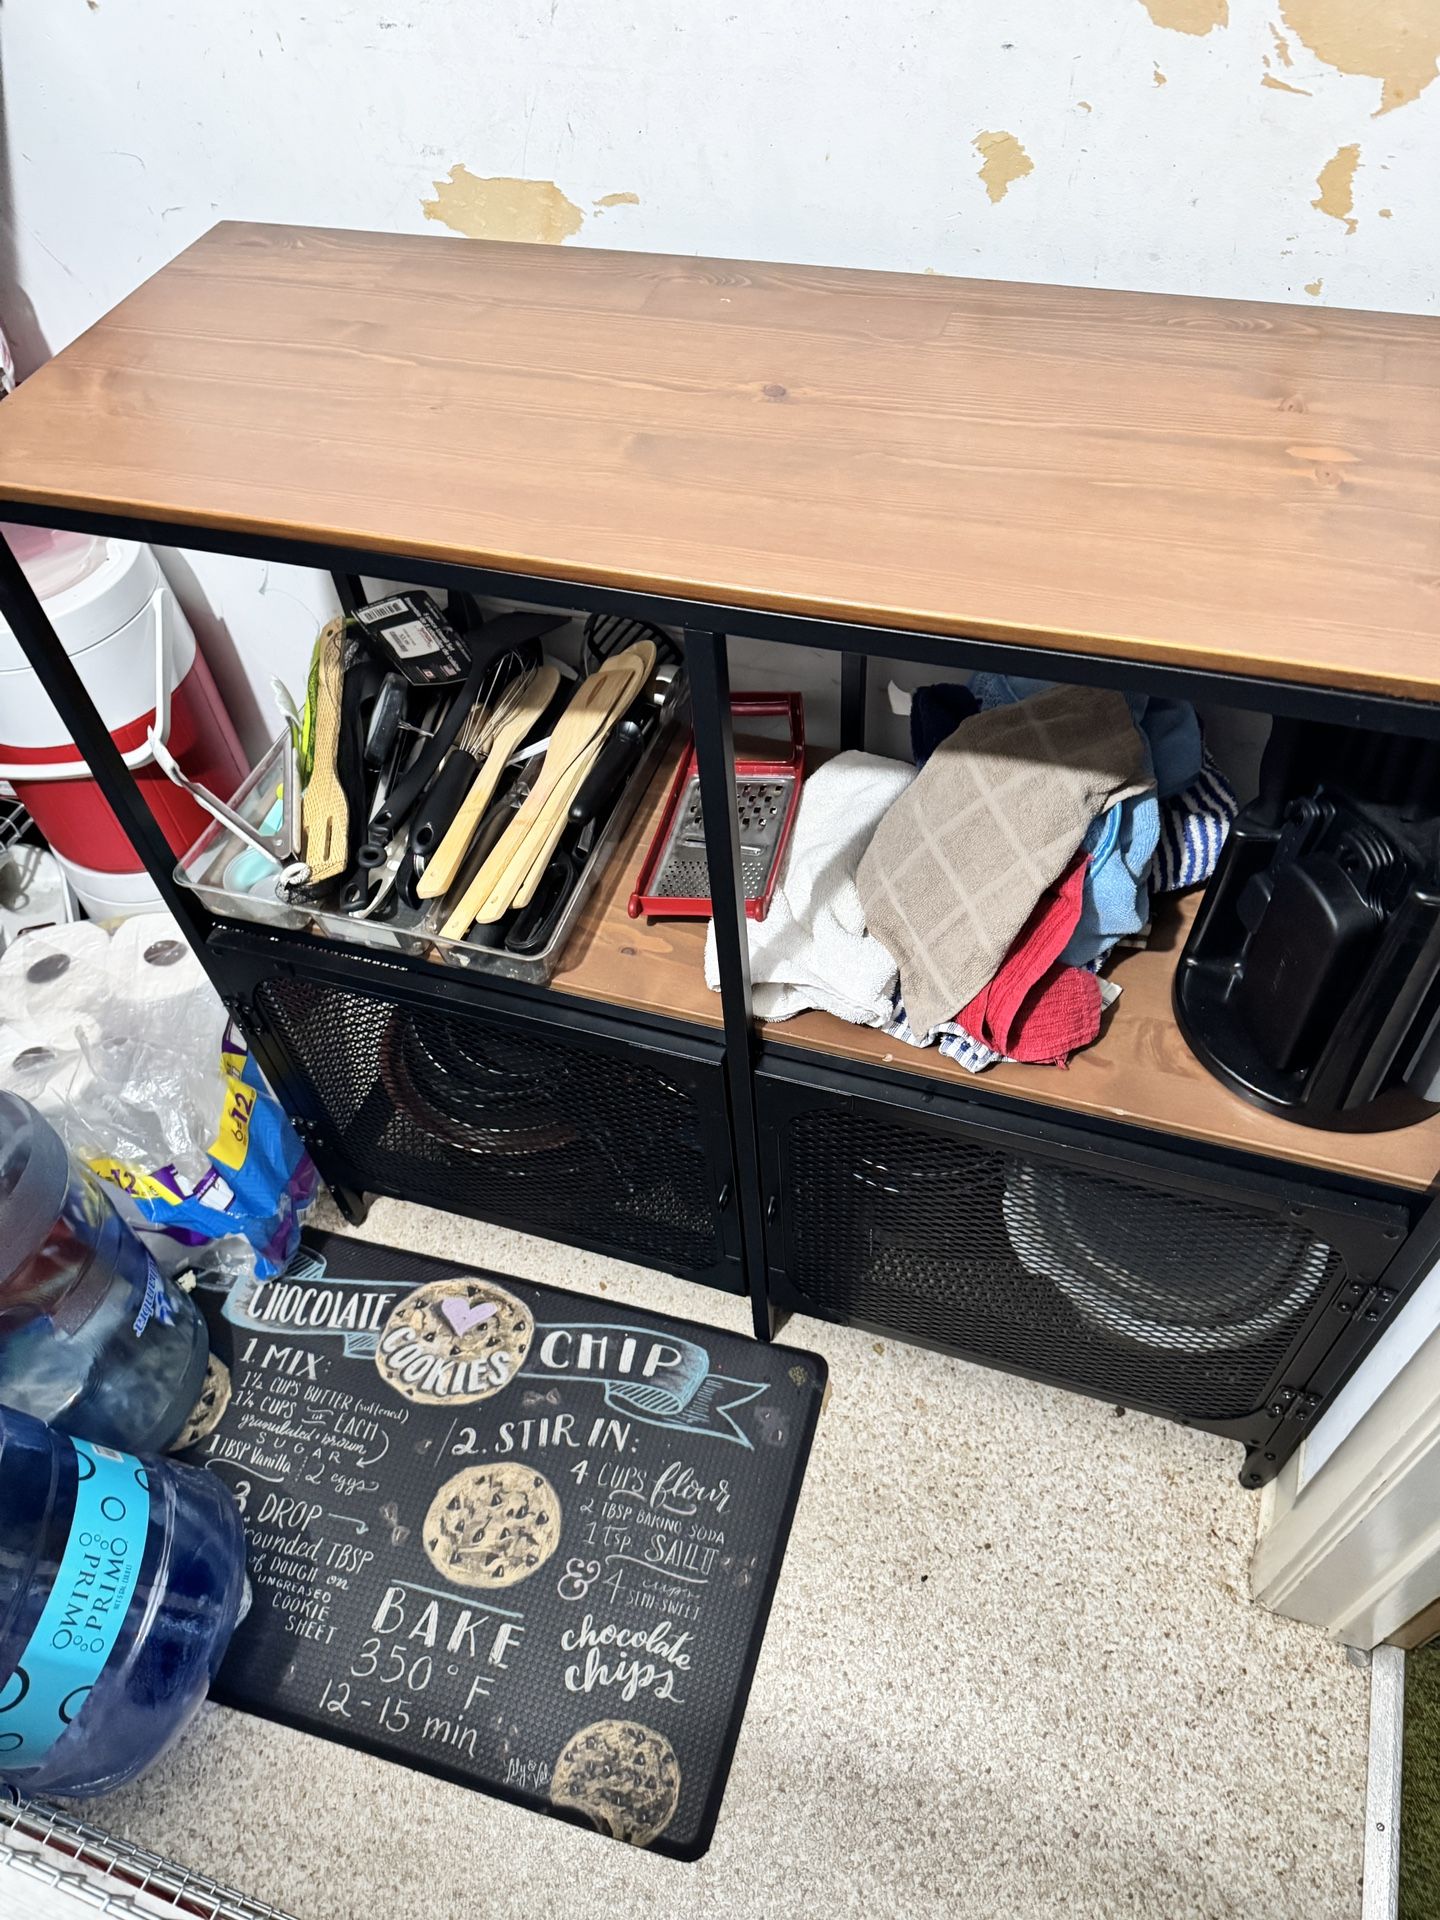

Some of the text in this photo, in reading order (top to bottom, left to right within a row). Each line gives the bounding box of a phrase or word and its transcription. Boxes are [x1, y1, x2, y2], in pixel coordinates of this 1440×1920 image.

[248, 1283, 397, 1331] CHOCOLATE
[240, 1338, 332, 1380] 1. MIX:
[382, 1327, 511, 1397] COOKIES
[540, 1330, 682, 1377] CHIP
[269, 1376, 302, 1397] CUPS
[304, 1385, 354, 1411] BUTTER
[238, 1414, 367, 1455] granulated brown
[260, 1395, 297, 1419] CUPS
[334, 1413, 379, 1441] EACH
[451, 1413, 641, 1455] 2. STIR IN:
[220, 1438, 250, 1460] TBSP
[250, 1447, 291, 1473] Vanilla
[305, 1464, 380, 1496] 2 eggs
[570, 1459, 731, 1513] 4 CUPS flour
[257, 1492, 323, 1531] DROP
[579, 1498, 725, 1545] 2 TBSP BAKING SODA
[325, 1542, 374, 1574] TBSP
[583, 1521, 597, 1545] 1
[644, 1533, 720, 1575] SALT
[85, 1537, 128, 1632] PRIMO
[257, 1574, 332, 1604] UNGREASED
[269, 1555, 318, 1583] DOUGH
[326, 1575, 349, 1590] on
[557, 1557, 601, 1601] &
[602, 1568, 625, 1604] 4
[52, 1552, 101, 1650] PRIMO
[272, 1591, 330, 1622] COOKIE
[285, 1614, 338, 1644] SHEET
[371, 1586, 525, 1669] BAKE
[560, 1613, 695, 1670] chocolate
[564, 1647, 685, 1703] chips
[422, 1714, 478, 1758] min
